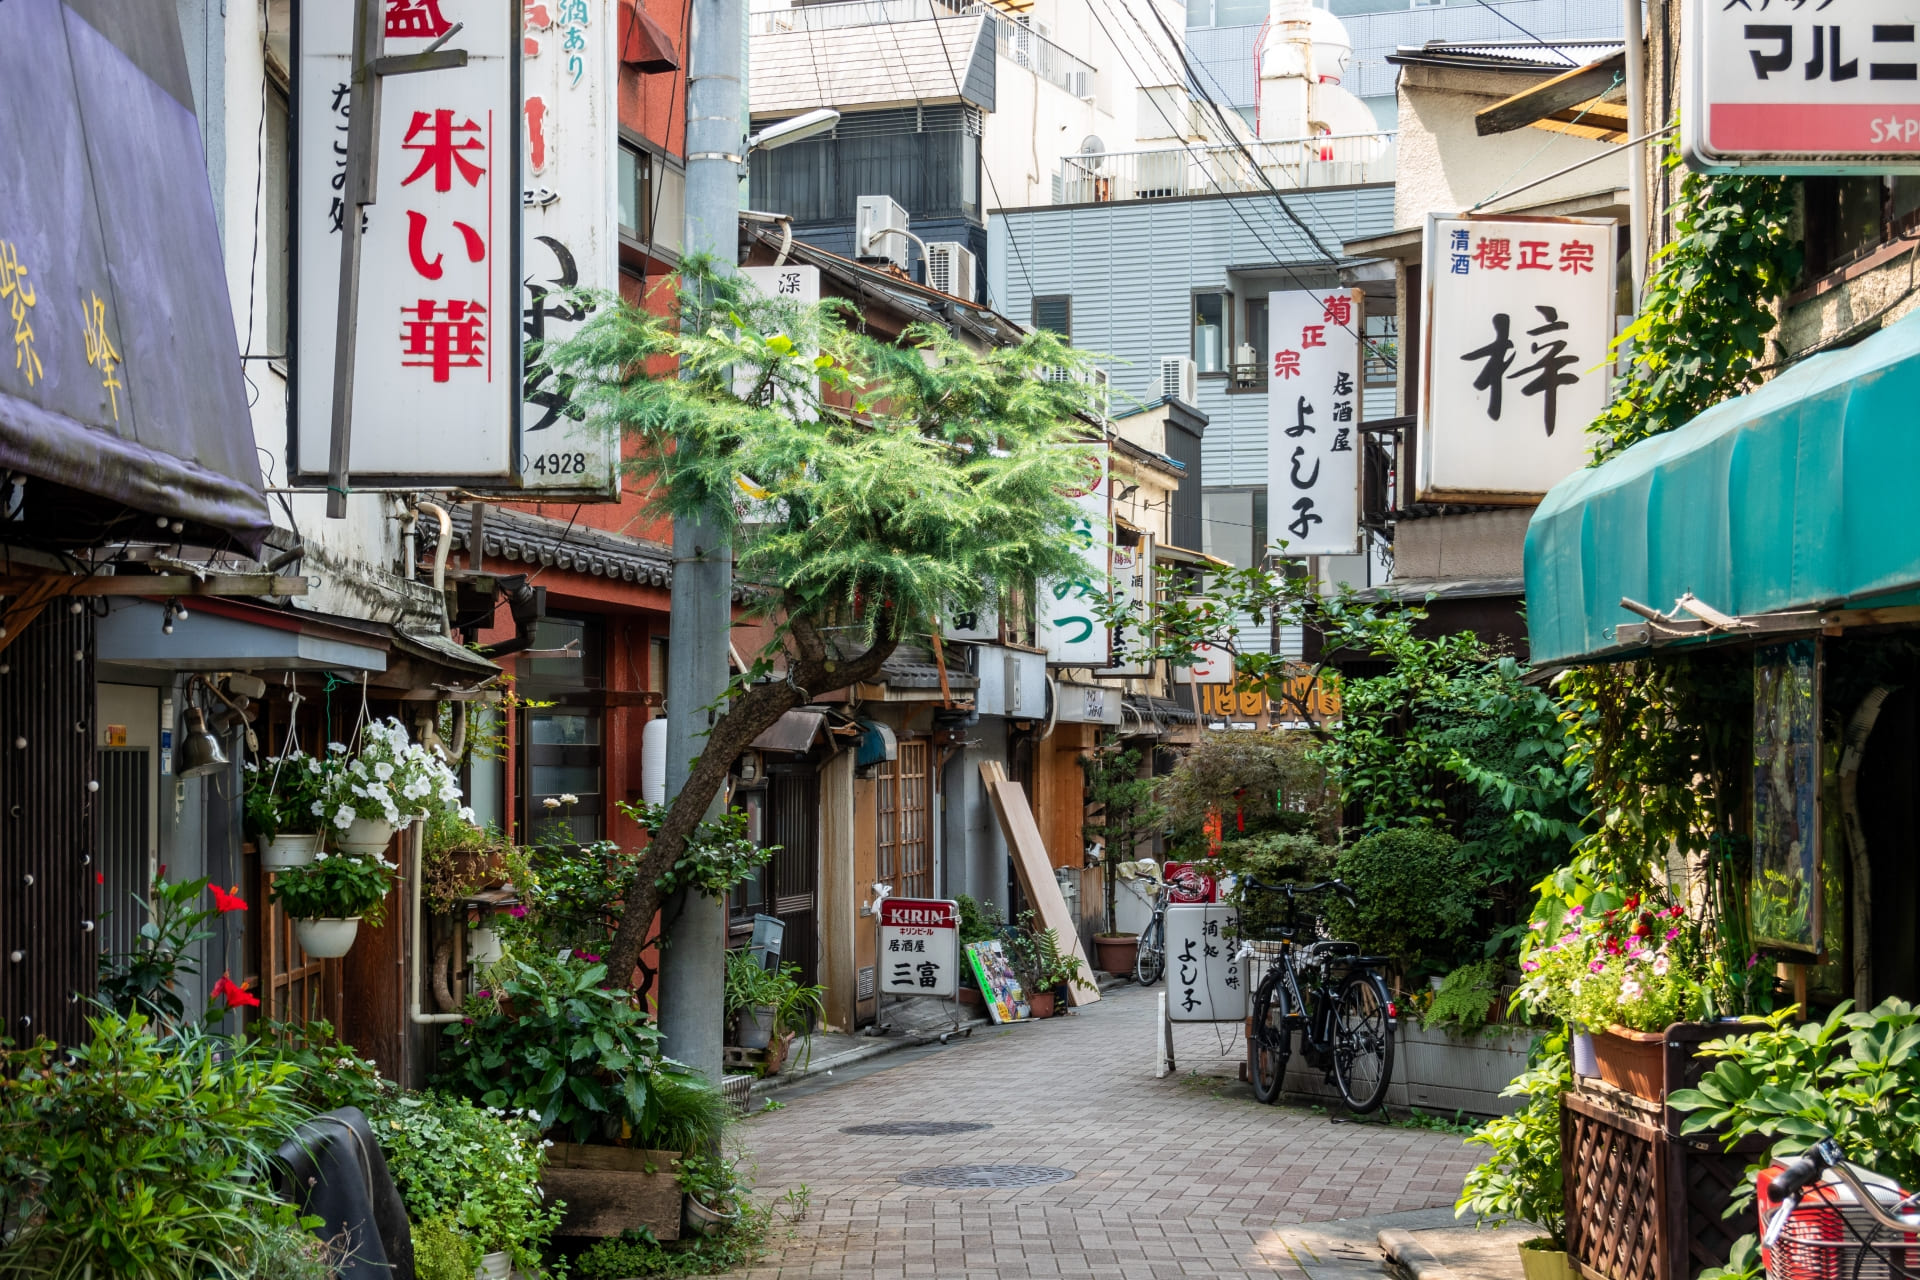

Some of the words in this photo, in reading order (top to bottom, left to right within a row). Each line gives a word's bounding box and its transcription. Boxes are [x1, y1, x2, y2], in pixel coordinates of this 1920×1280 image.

[401, 109, 486, 383] 朱い華
[1450, 229, 1469, 275] 清酒
[1473, 236, 1594, 274] 櫻正宗
[1274, 295, 1351, 379] 菊正宗
[1460, 306, 1580, 437] 梓
[1331, 371, 1353, 452] 居酒屋
[1285, 397, 1322, 538] よし子
[891, 908, 943, 925] KIRIN
[900, 927, 934, 936] キリンビール
[1202, 920, 1219, 958] 酒処
[888, 939, 926, 953] 居酒屋
[891, 961, 940, 988] 三富
[1178, 938, 1201, 1013] よし子
